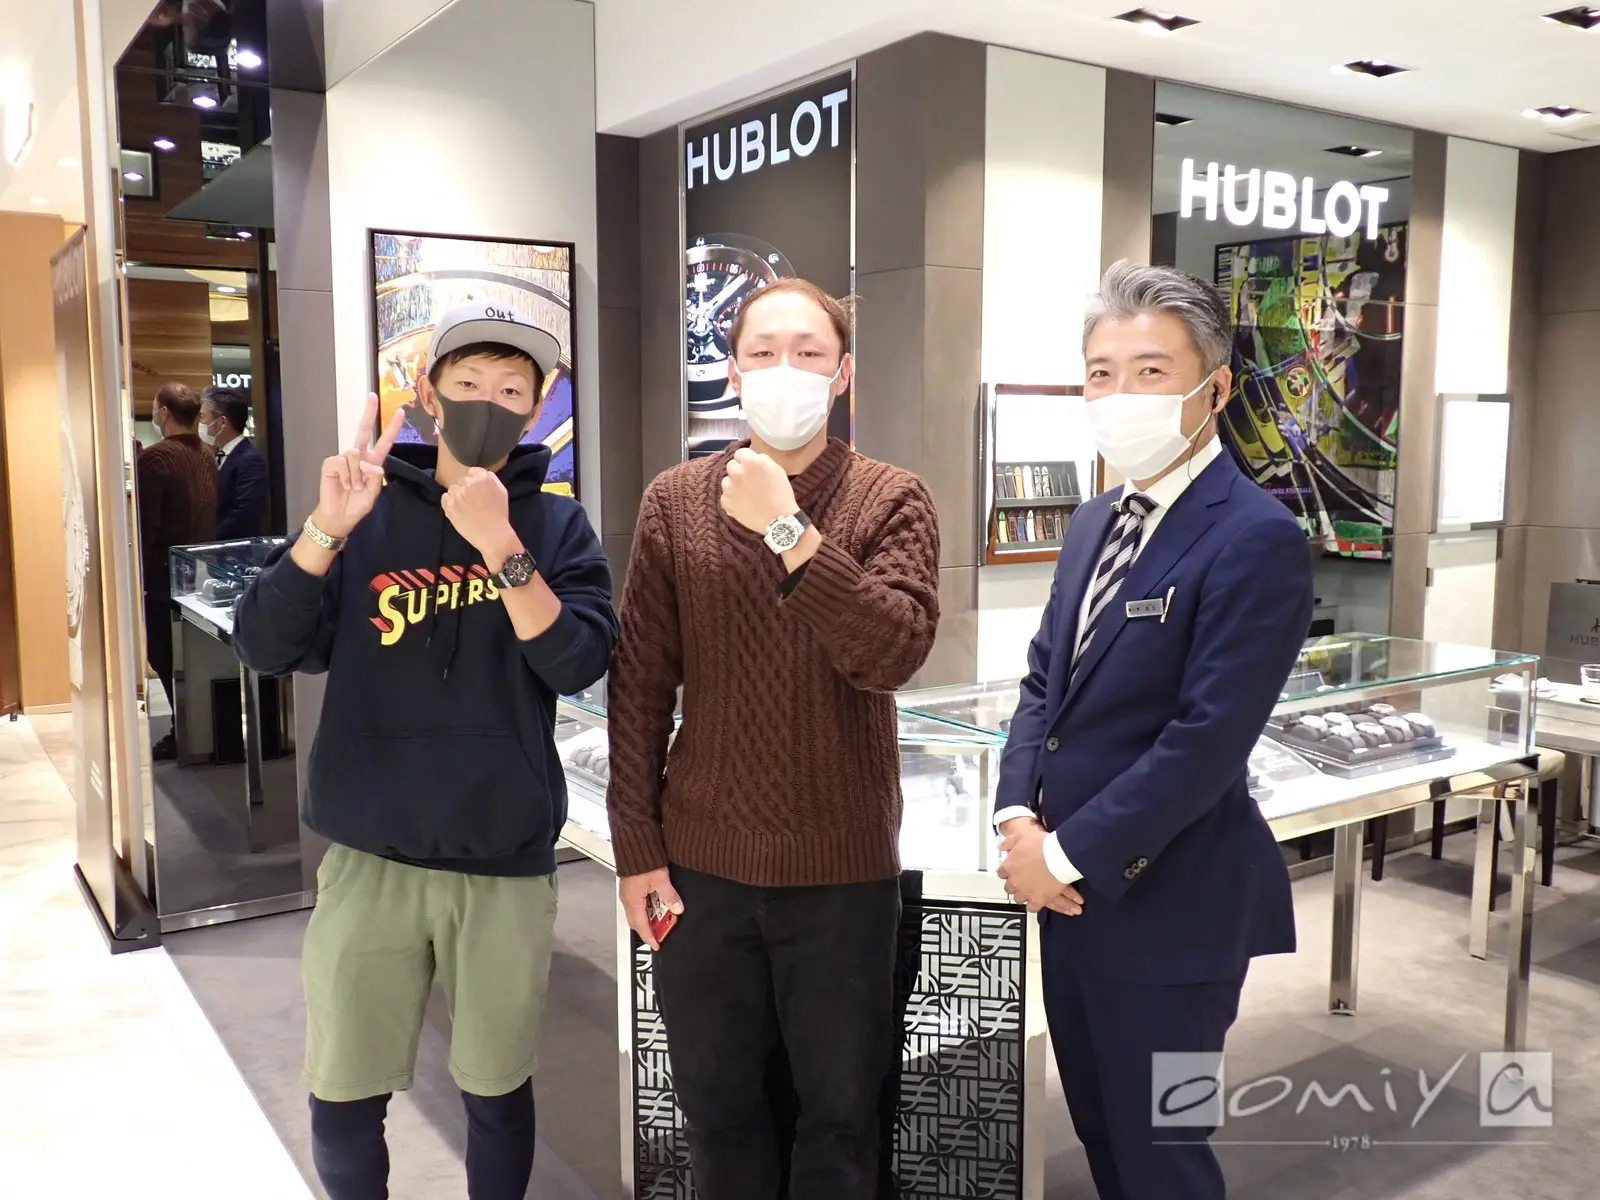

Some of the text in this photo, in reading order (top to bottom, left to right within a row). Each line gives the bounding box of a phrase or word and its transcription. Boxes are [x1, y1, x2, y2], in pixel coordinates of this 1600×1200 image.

[687, 88, 848, 189] HUBLOT
[1180, 158, 1389, 240] HUBLOT
[485, 306, 515, 321] Out
